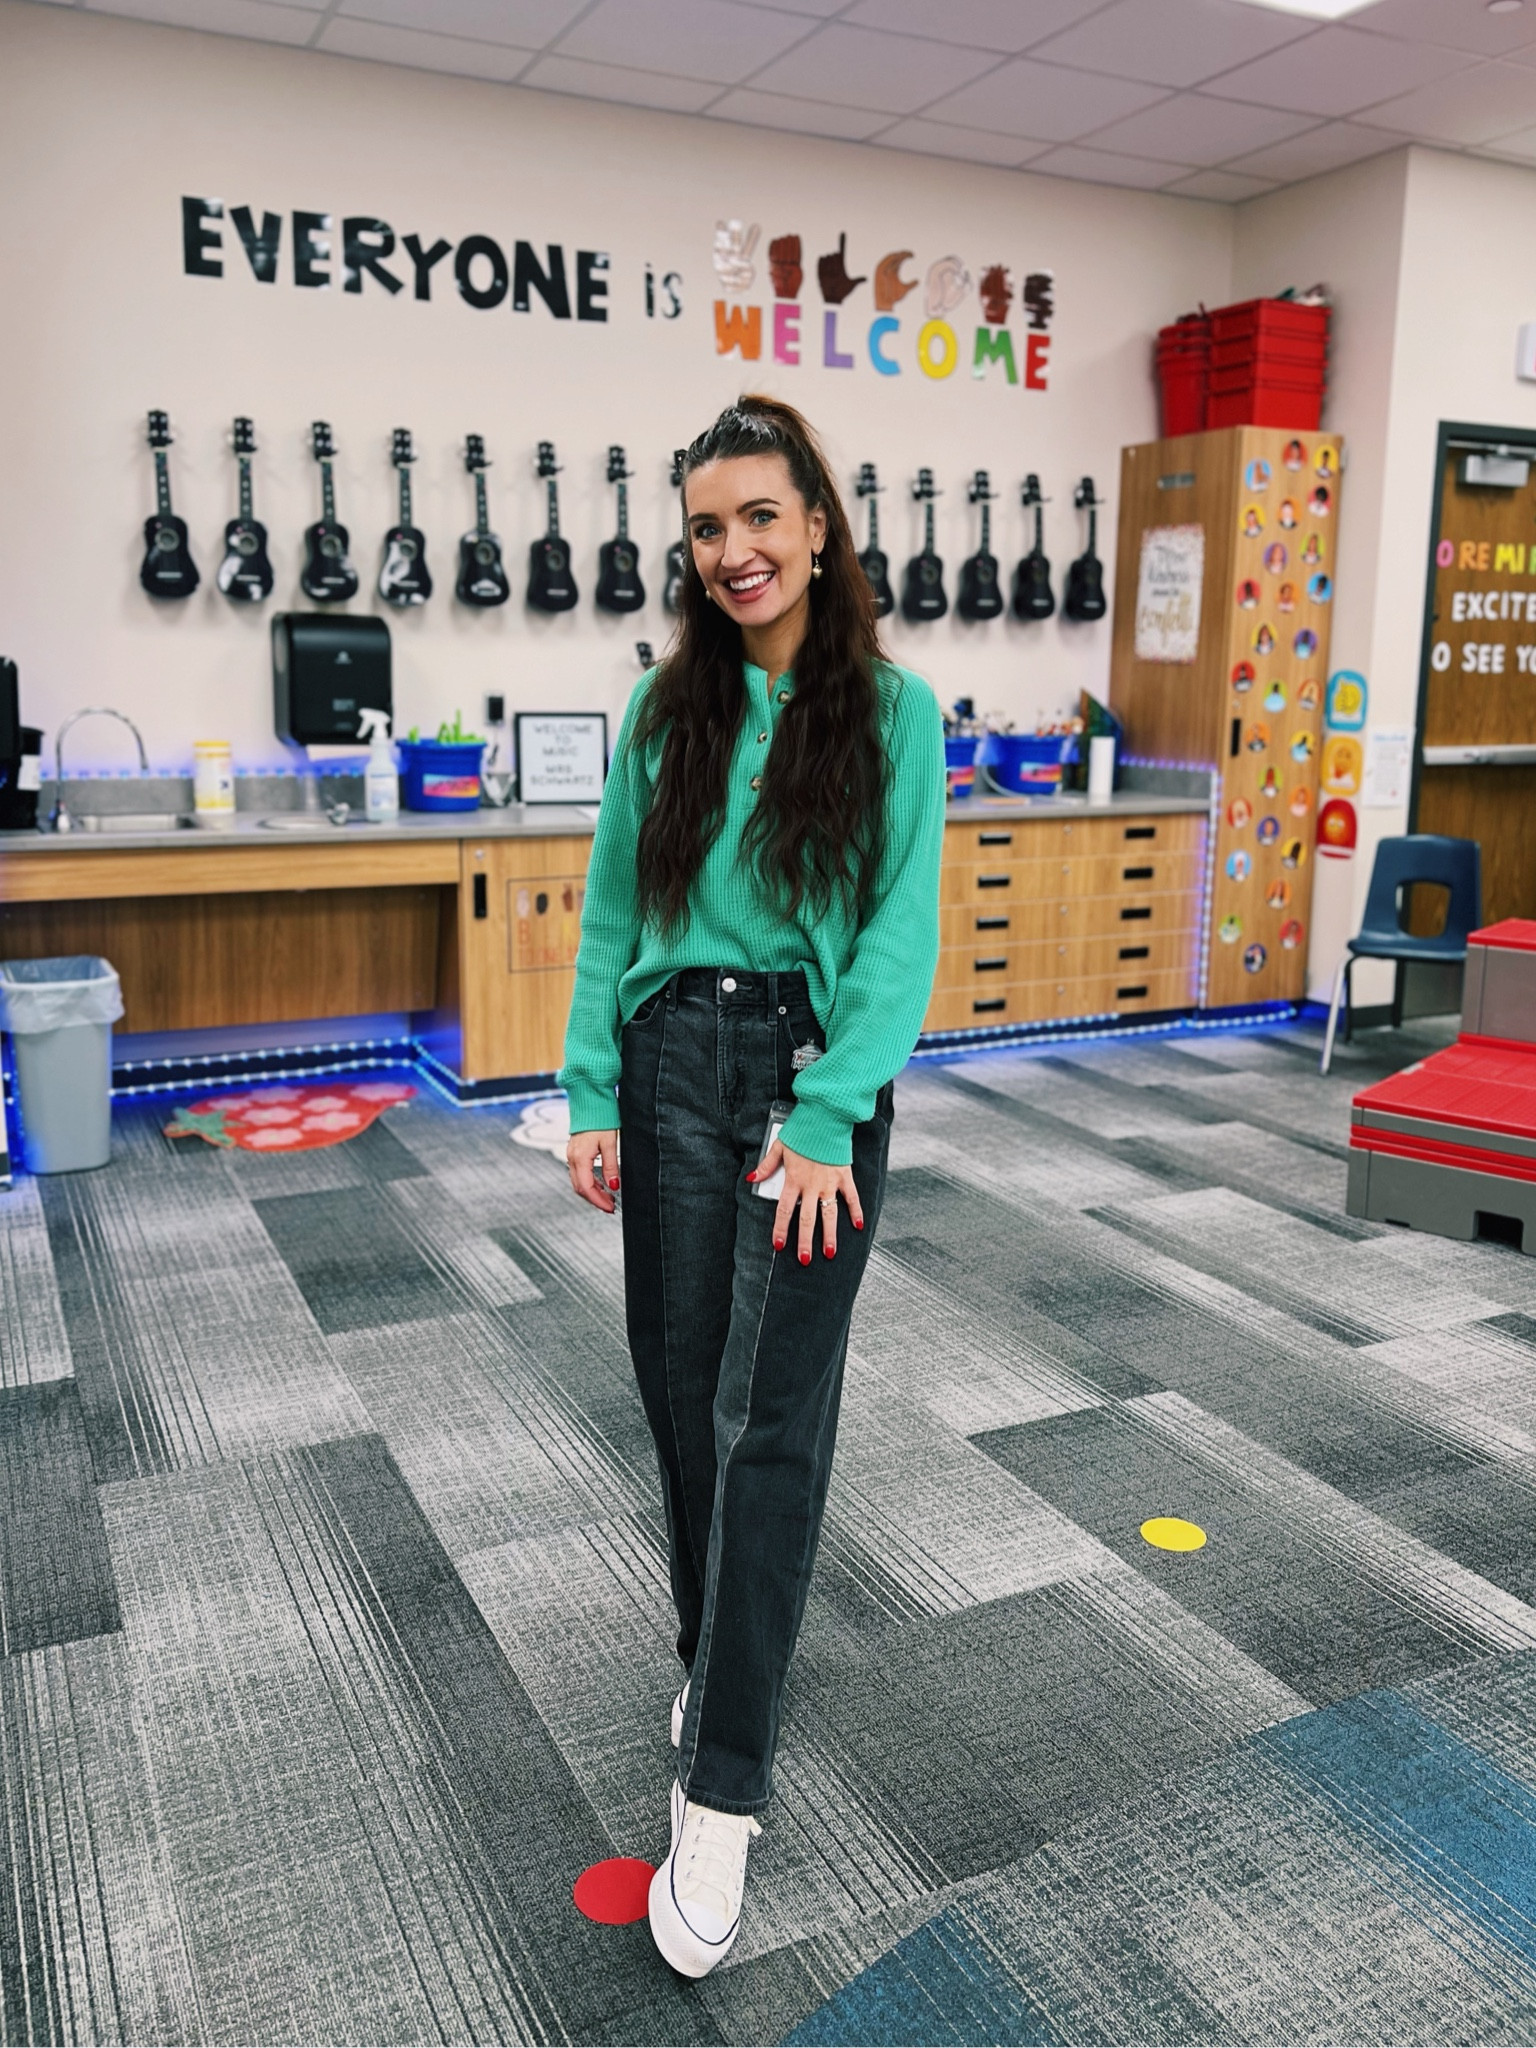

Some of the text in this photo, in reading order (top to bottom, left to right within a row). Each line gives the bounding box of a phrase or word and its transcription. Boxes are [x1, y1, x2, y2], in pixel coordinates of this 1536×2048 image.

[181, 196, 1051, 391] EVERYONE is WELCOME
[1458, 540, 1491, 572] RE
[1461, 642, 1506, 674] SEE
[534, 724, 593, 735] WELCOME
